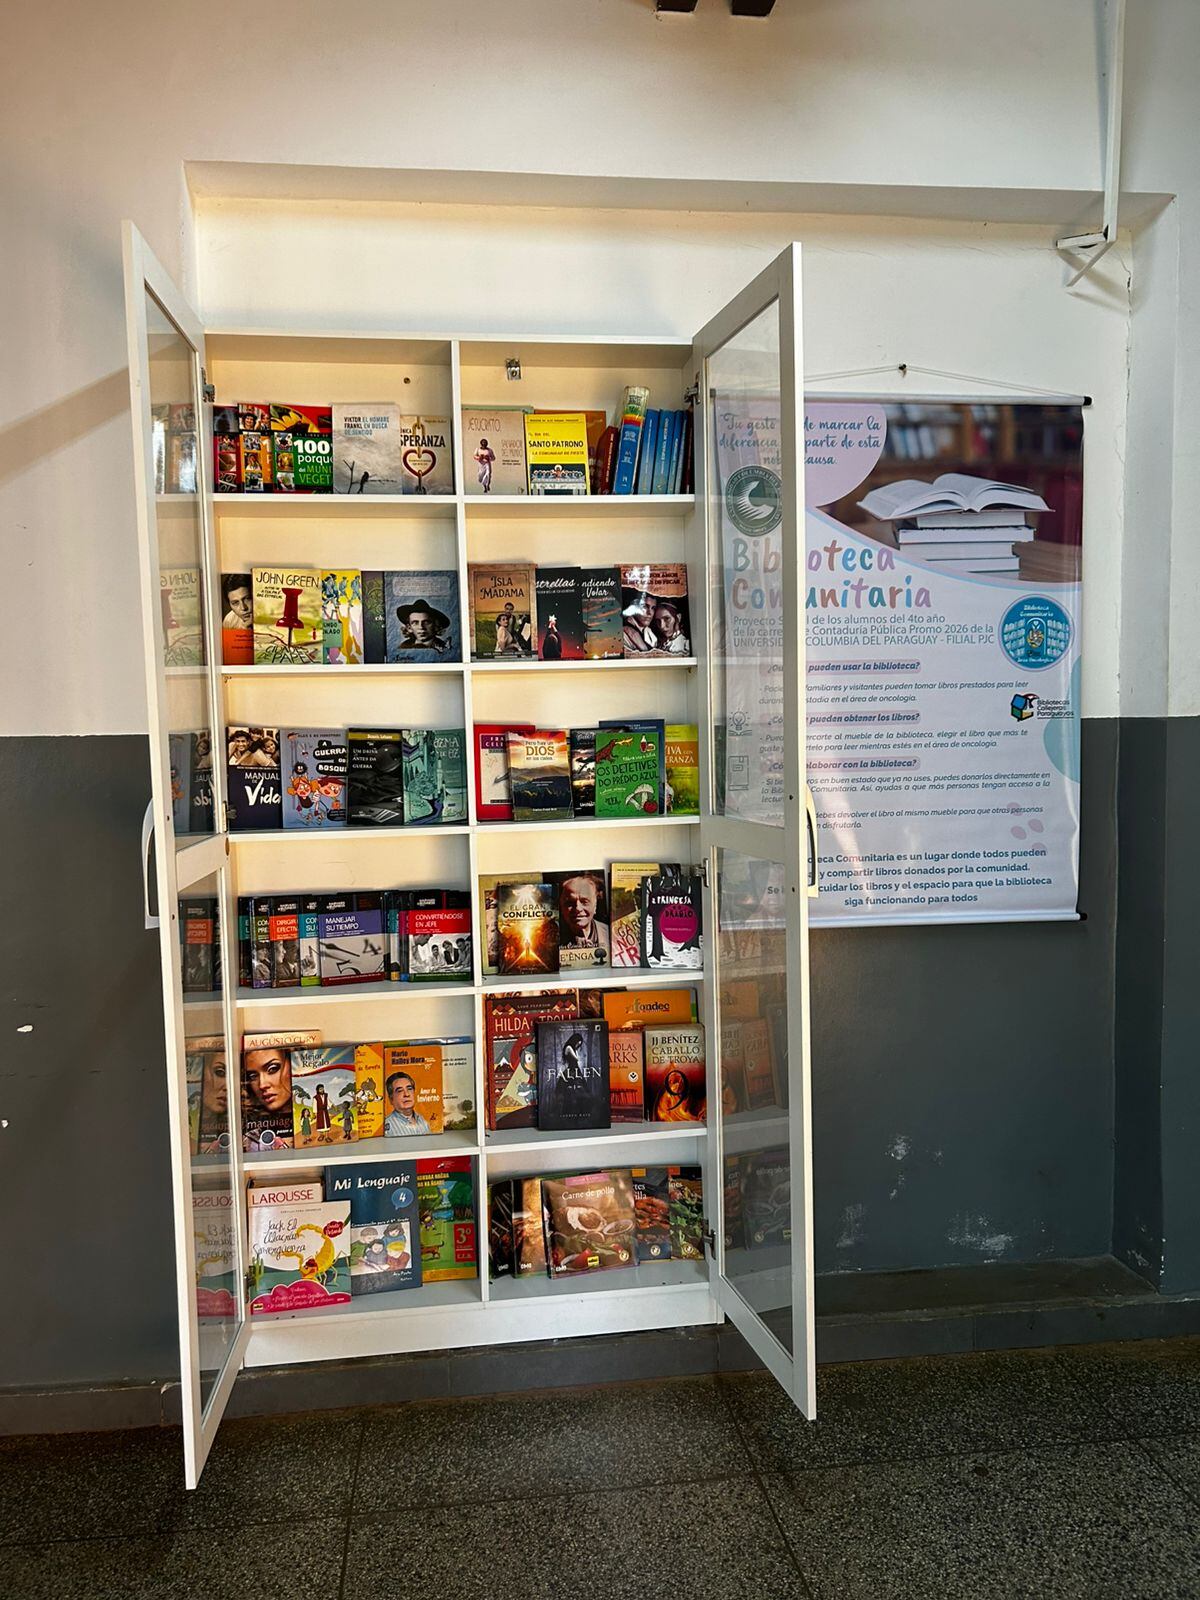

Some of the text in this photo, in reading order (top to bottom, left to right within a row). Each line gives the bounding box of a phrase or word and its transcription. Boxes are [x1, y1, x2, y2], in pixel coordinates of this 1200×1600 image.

[819, 421, 863, 431] marcar
[866, 415, 882, 431] la
[400, 434, 446, 447] SPERANZA
[528, 440, 584, 448] SANTO PATRONO
[841, 434, 854, 449] de
[858, 434, 881, 448] esta
[299, 474, 330, 485] VEGET
[732, 537, 896, 574] Biboteca
[256, 571, 320, 589] JOHN GREEN
[490, 576, 513, 588] ISLA
[536, 578, 575, 589] strellas
[480, 587, 525, 600] MADAMA
[811, 615, 825, 625] de
[827, 614, 842, 625] los
[845, 614, 887, 625] alumnos
[889, 614, 906, 624] del
[907, 614, 925, 624] 4to
[926, 614, 946, 623] año
[812, 623, 994, 636] Contaduría Pública Promo 2026 de la
[805, 633, 995, 647] COLUMBIA DEL PARAGUAY FILIAL PJC
[808, 661, 920, 673] pueden usar la biblioteca?
[915, 682, 937, 690] tomar
[938, 681, 958, 689] libros
[959, 681, 995, 690] prestados
[996, 682, 1014, 690] para
[1015, 680, 1029, 688] leer
[809, 713, 920, 725] pueden obtener los libros?
[968, 729, 986, 737] libro
[314, 747, 347, 756] GUERRA
[525, 745, 555, 756] DIOS
[596, 760, 658, 777] OS DETETIVES
[842, 761, 858, 769] con
[859, 760, 868, 768] la
[869, 758, 917, 768] biblioteca?
[245, 771, 280, 781] MANUAL
[598, 778, 612, 787] DO
[640, 771, 660, 781] AZUL
[245, 777, 281, 806] Vida
[835, 853, 895, 863] Comunitaria
[909, 853, 923, 861] un
[924, 852, 949, 862] lugar
[951, 850, 981, 860] donde
[982, 850, 1009, 859] todos
[1011, 849, 1047, 859] pueden
[819, 863, 1031, 880] y compartir libros donados por la comunidad.
[818, 877, 1052, 892] cuidar los libros y el espacio para que la biblioteca
[844, 894, 978, 908] siga funcionando para todos
[325, 916, 356, 924] MANEJAR
[502, 910, 553, 919] CONFLICTO
[336, 923, 359, 931] TIEMPO
[495, 1017, 530, 1033] HILDA
[249, 1037, 292, 1048] AUGUSTO
[661, 1034, 699, 1045] BENÍTEZ
[391, 1050, 408, 1058] Mario
[652, 1046, 700, 1056] CABALLO
[300, 1053, 323, 1062] Mejor
[652, 1055, 700, 1064] DE TROYA
[302, 1059, 330, 1069] Regalo
[547, 1067, 602, 1083] FALLEN
[664, 1069, 690, 1112] 9
[247, 1117, 293, 1130] maquiag
[334, 1178, 352, 1192] Mi
[357, 1172, 411, 1189] Lenguaje
[252, 1189, 314, 1206] LAROUSSE
[399, 1192, 406, 1203] 4
[561, 1186, 615, 1201] Carne de pollo
